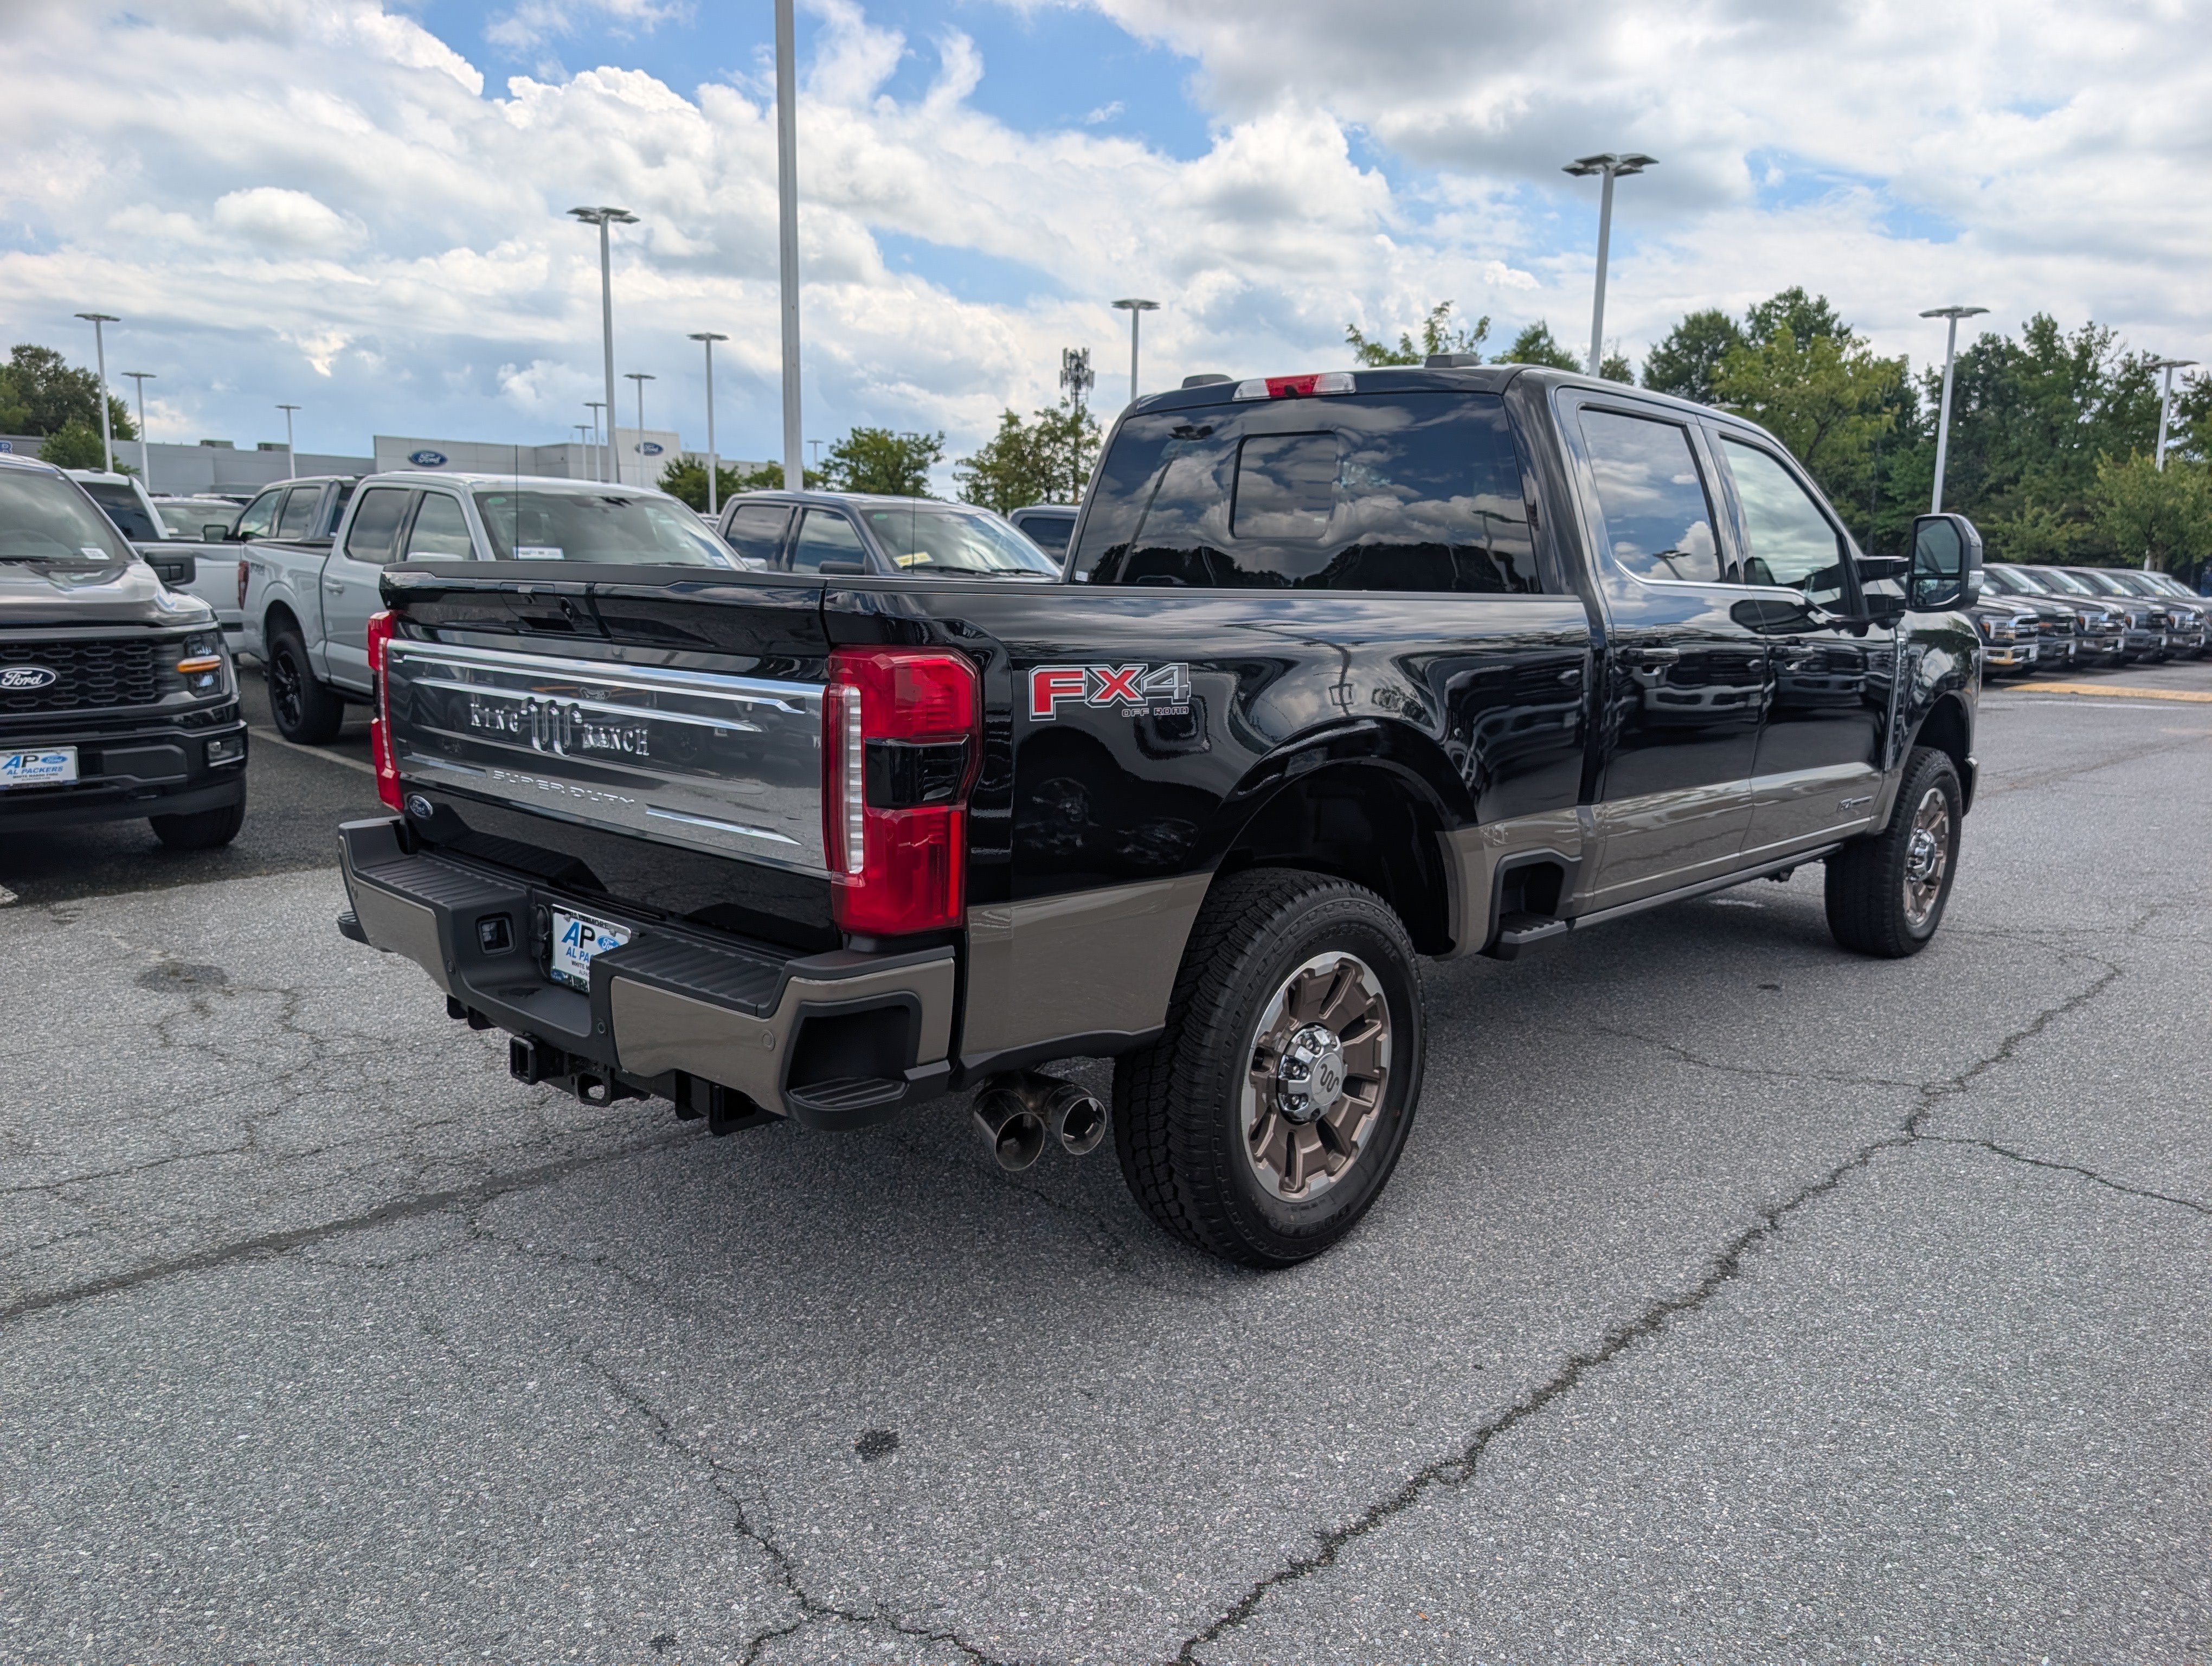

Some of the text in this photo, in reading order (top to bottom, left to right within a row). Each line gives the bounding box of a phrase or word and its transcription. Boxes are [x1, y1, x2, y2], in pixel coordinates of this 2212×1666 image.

[419, 452, 441, 464] Ford
[2, 670, 43, 686] Ford
[1028, 663, 1191, 722] FX4
[1122, 707, 1189, 717] OFF ROAD
[470, 702, 650, 756] KING RANCH
[2, 754, 40, 770] AP
[22, 766, 63, 774] PACKERS
[492, 770, 635, 808] SUPER DUTY
[562, 921, 596, 949] AP
[565, 947, 577, 959] AL
[571, 960, 585, 969] WHITE
